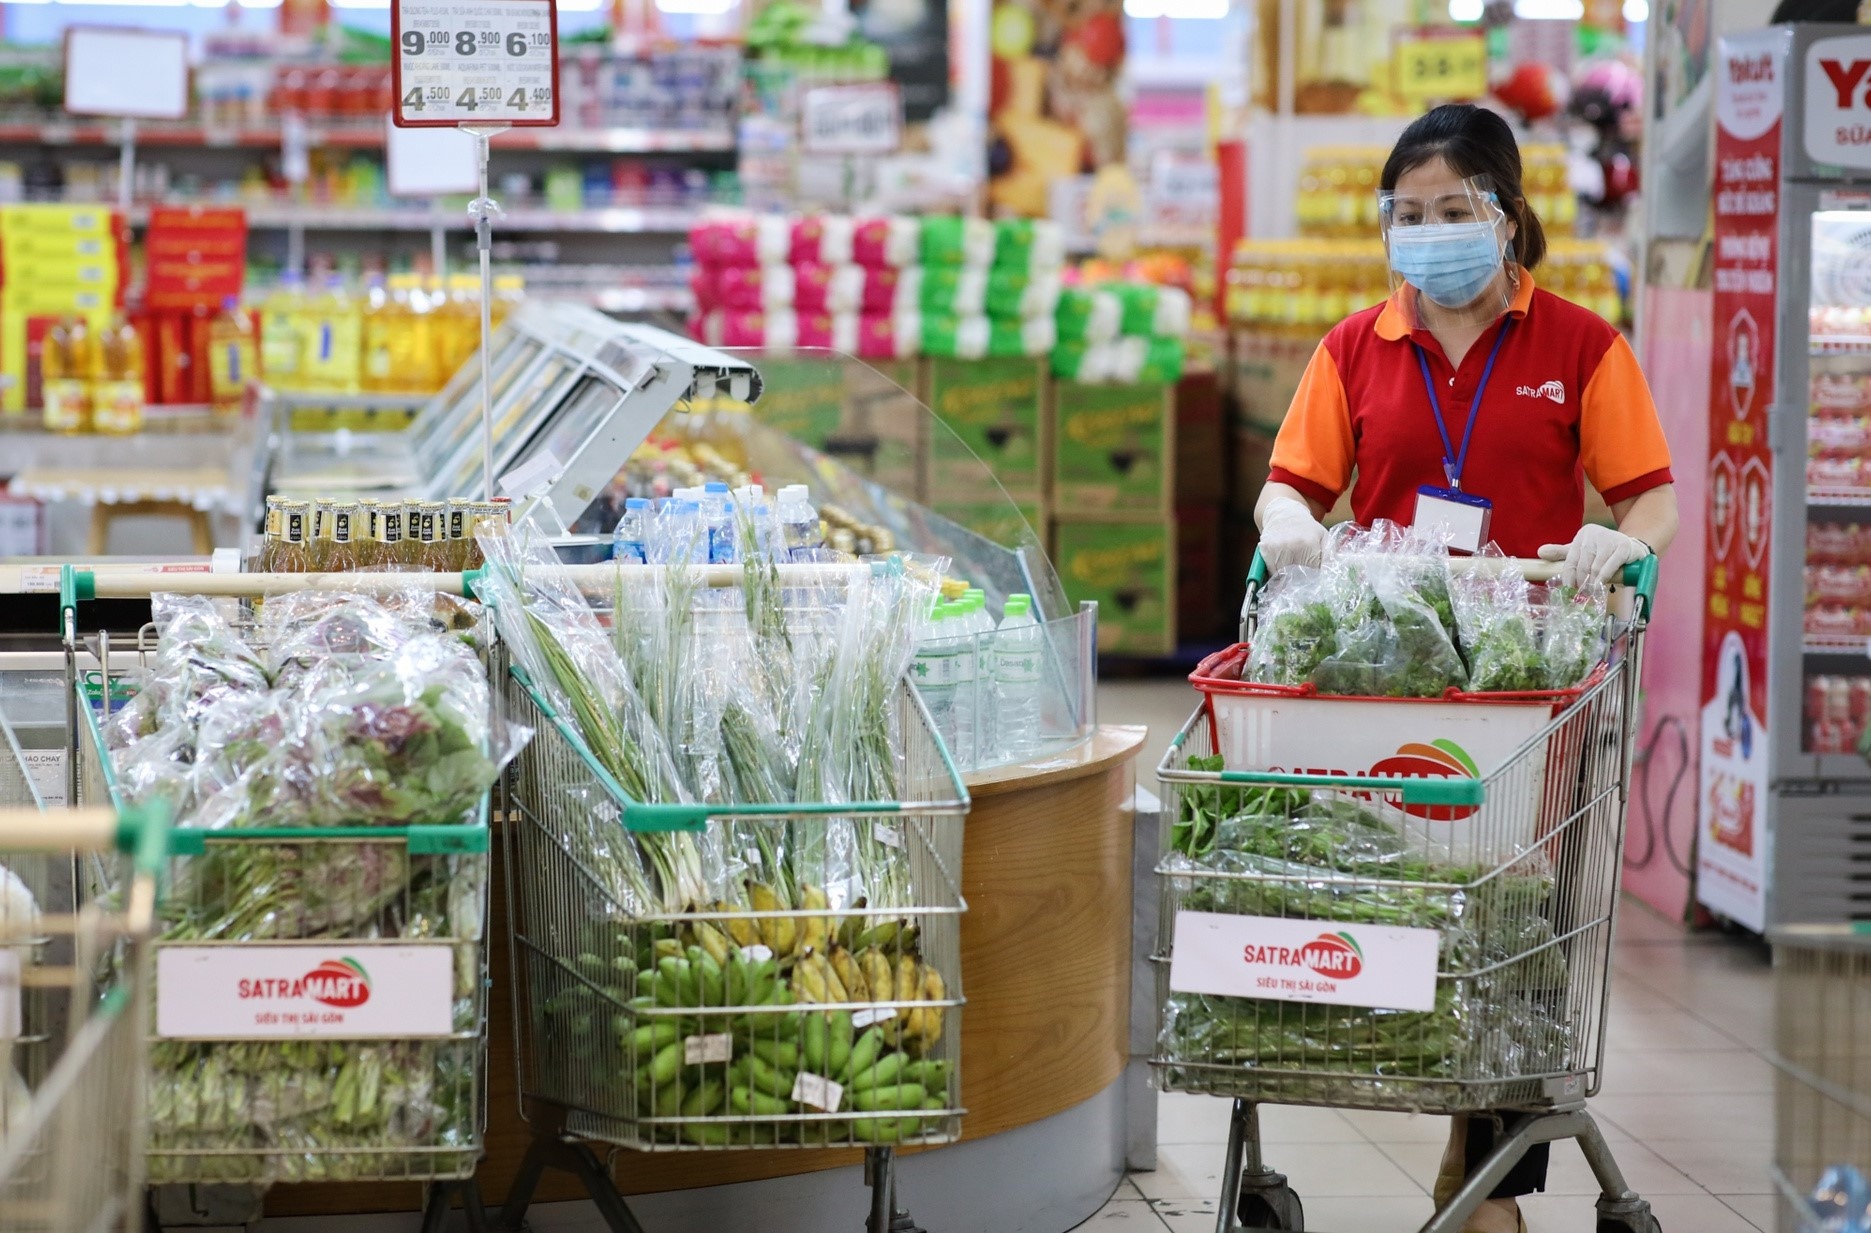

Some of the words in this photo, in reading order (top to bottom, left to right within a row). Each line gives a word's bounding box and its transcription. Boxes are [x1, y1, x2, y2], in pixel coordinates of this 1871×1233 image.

[1819, 58, 1871, 110] Y
[1244, 944, 1356, 971] SATRAMART
[238, 976, 362, 999] SATRAMART
